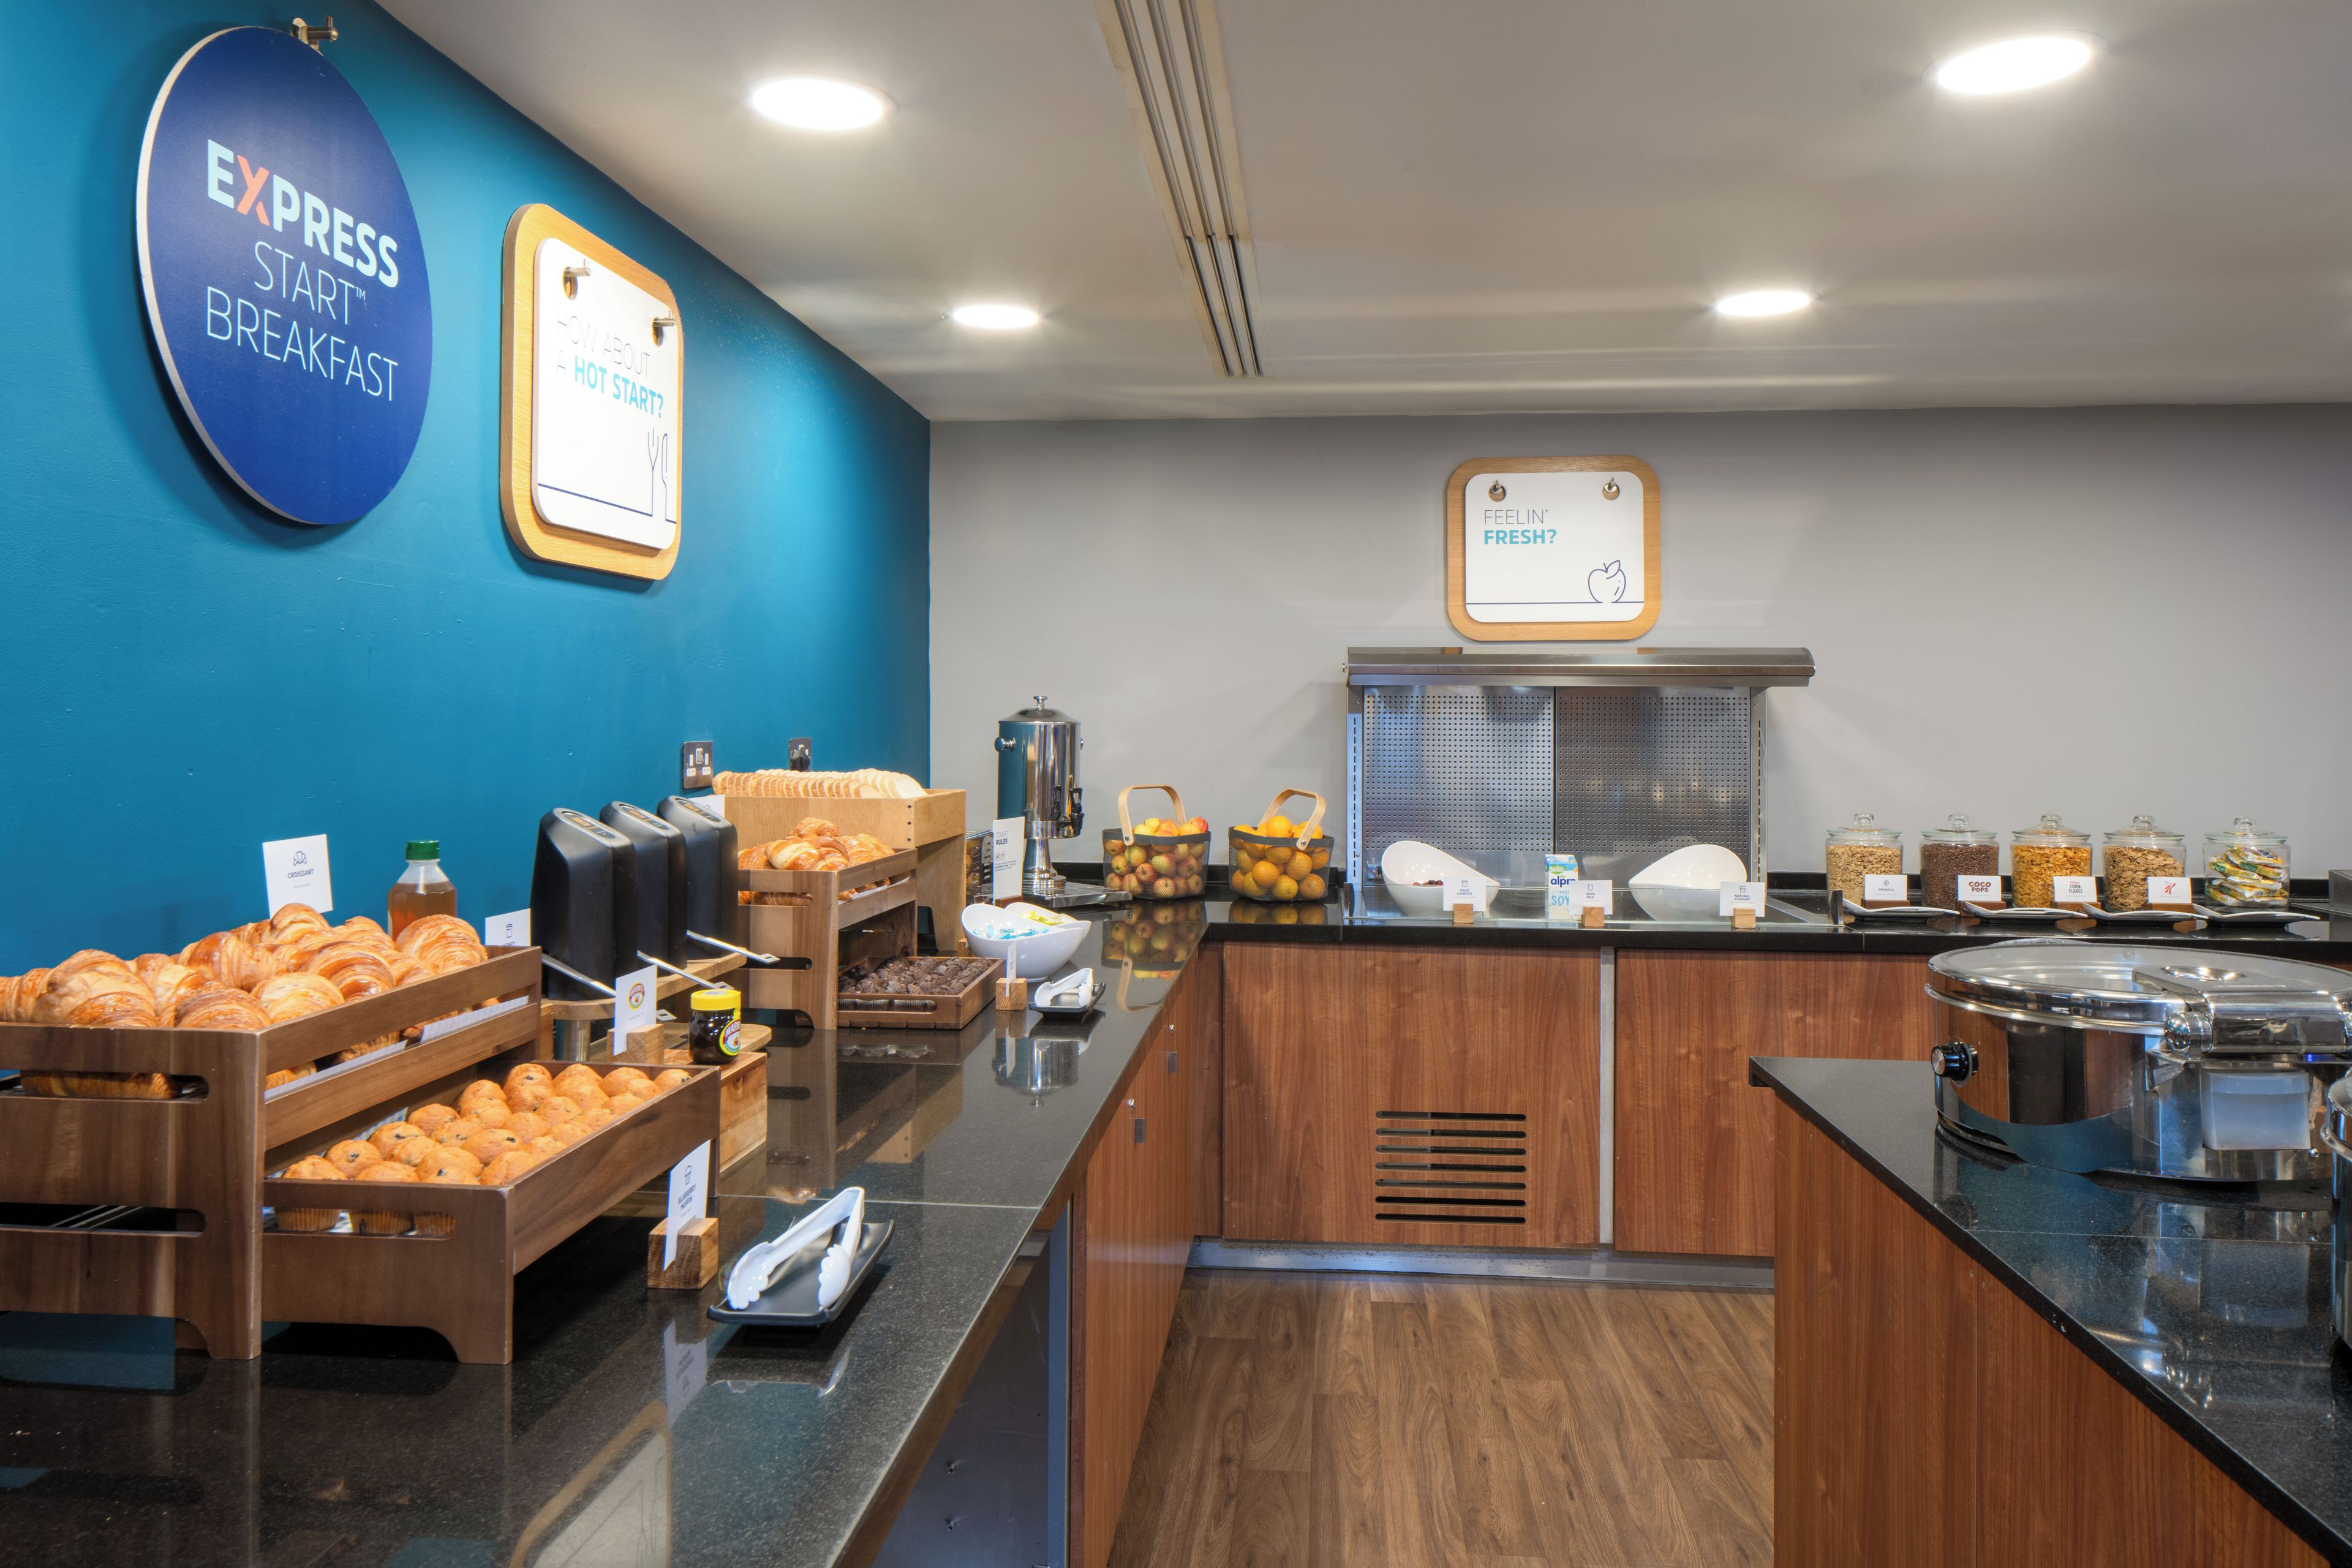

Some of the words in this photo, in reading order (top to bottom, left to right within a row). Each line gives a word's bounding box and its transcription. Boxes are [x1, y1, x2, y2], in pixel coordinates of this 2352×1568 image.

[208, 138, 398, 288] EXPRESS
[207, 285, 398, 402] BREAKFAST
[557, 309, 597, 352] HOW
[603, 333, 650, 378] ABOUT
[556, 349, 568, 378] A
[575, 355, 607, 393] HOT
[612, 373, 664, 418] START?
[1484, 529, 1558, 545] FRESH?
[287, 869, 314, 879] CROISSANT
[1550, 875, 1576, 888] alpr
